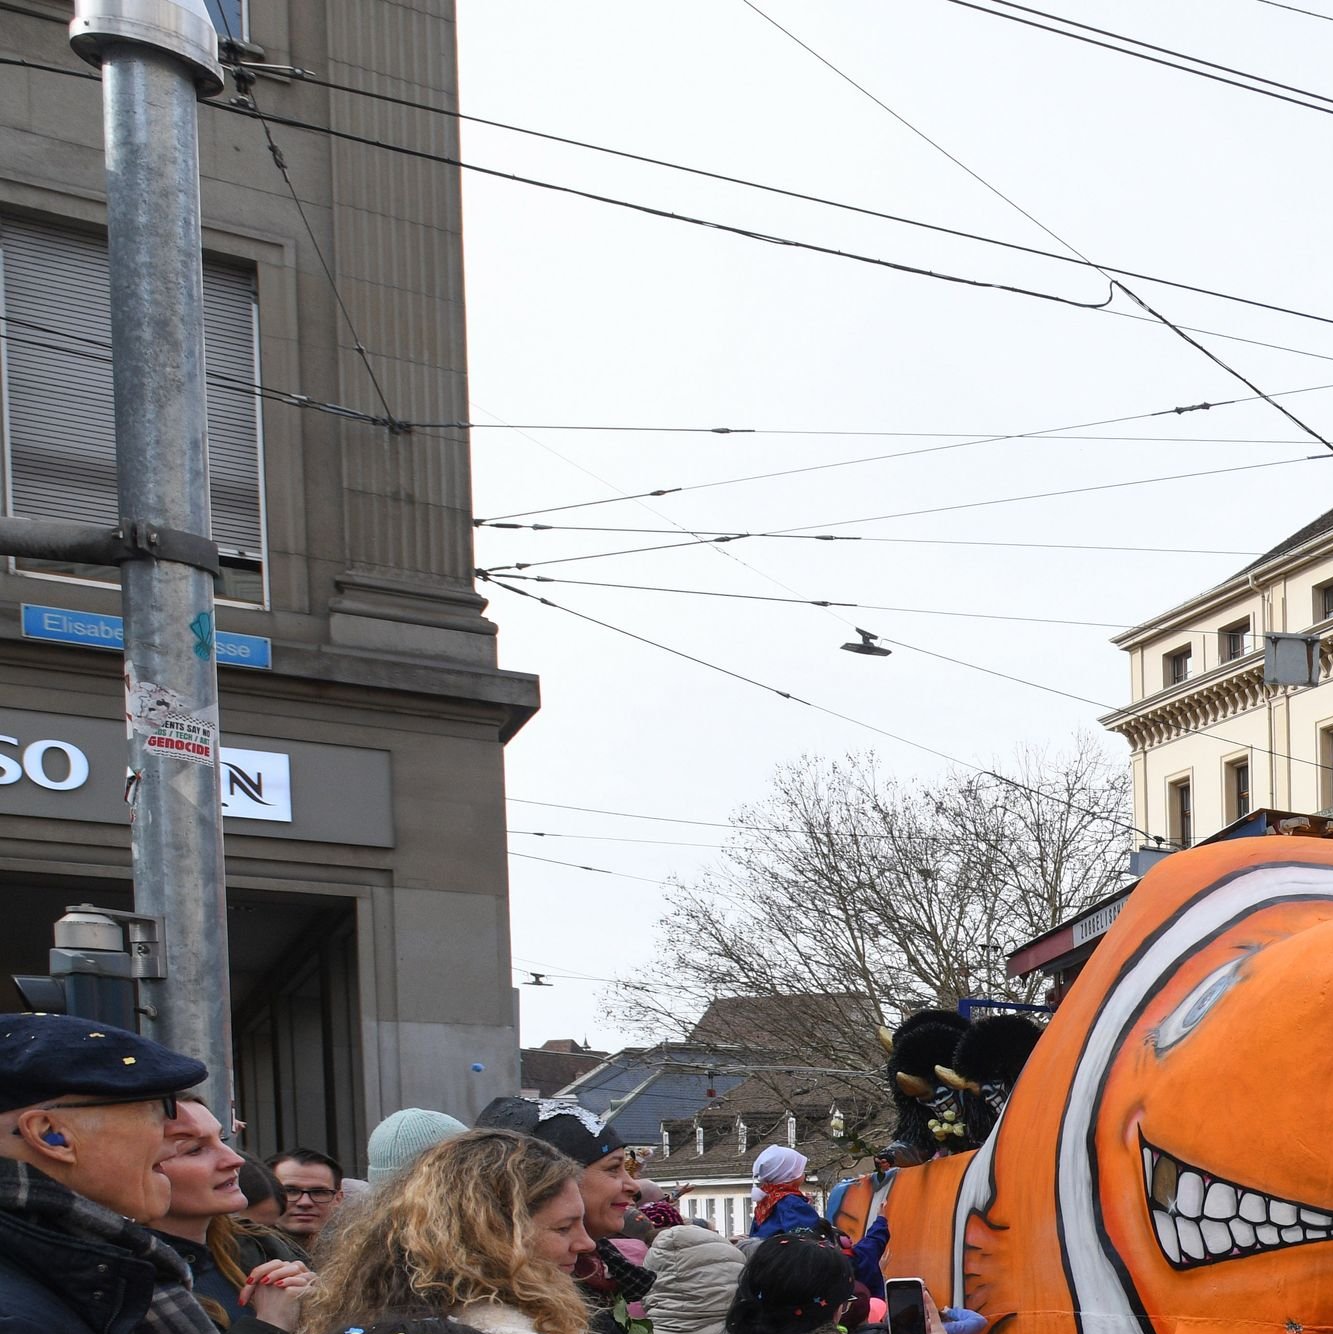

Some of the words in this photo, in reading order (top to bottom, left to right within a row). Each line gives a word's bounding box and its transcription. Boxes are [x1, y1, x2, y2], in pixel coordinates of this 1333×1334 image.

[187, 724, 201, 735] SAY
[176, 731, 192, 741] TECH
[148, 735, 210, 757] GENOCIDE
